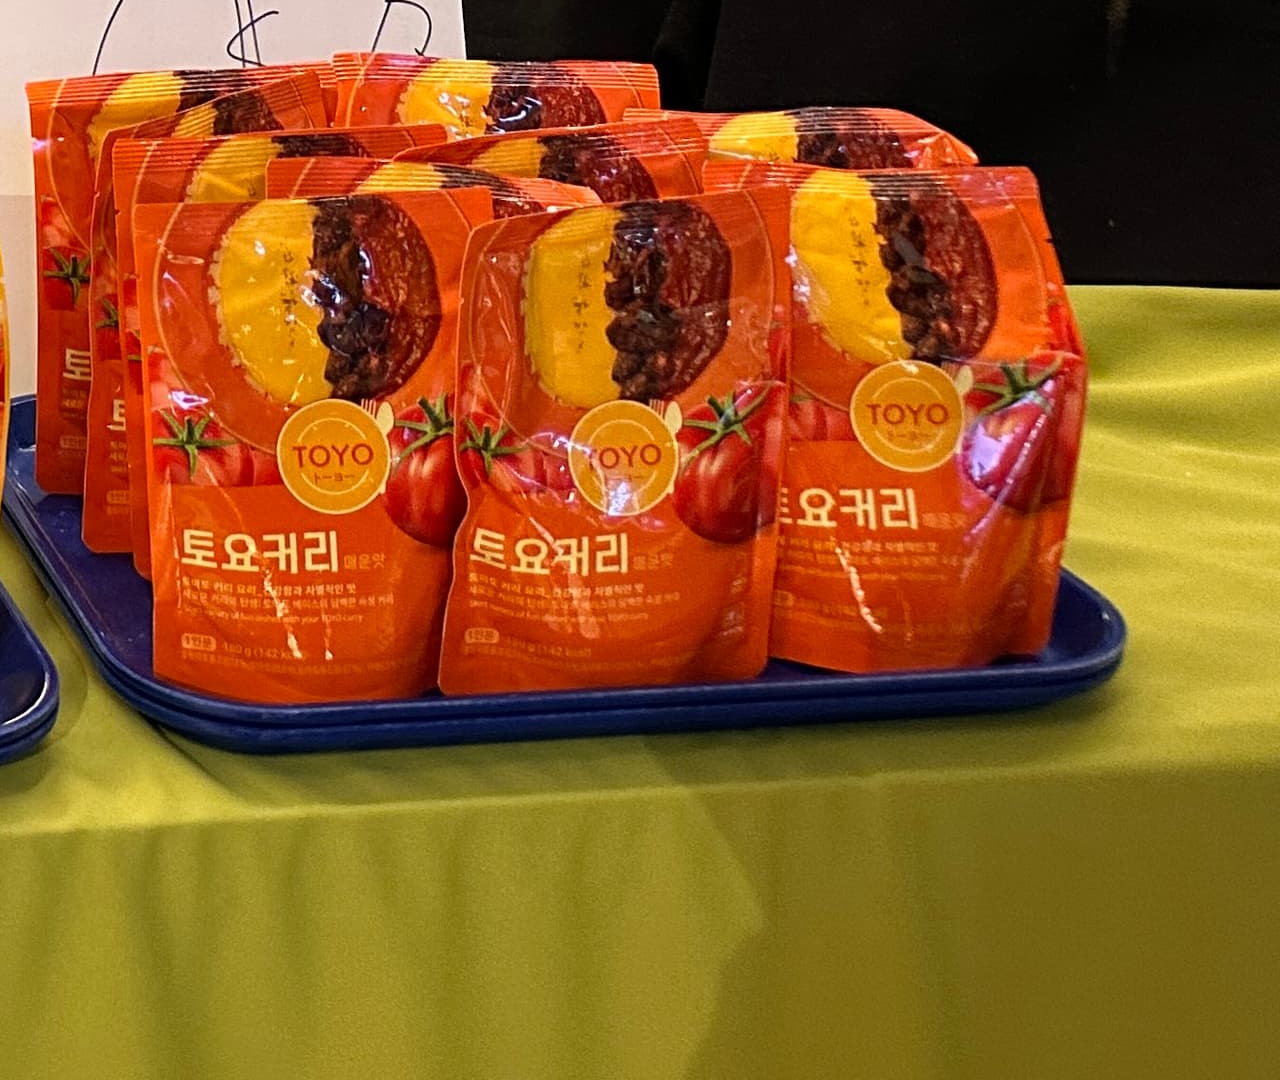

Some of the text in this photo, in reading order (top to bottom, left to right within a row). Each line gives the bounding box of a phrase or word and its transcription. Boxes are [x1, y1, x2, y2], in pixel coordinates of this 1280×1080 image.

[866, 403, 949, 425] TOYO
[292, 443, 374, 468] TOYO
[590, 444, 662, 469] OYO
[181, 528, 338, 574] 토요커리
[470, 528, 628, 576] 토요커리
